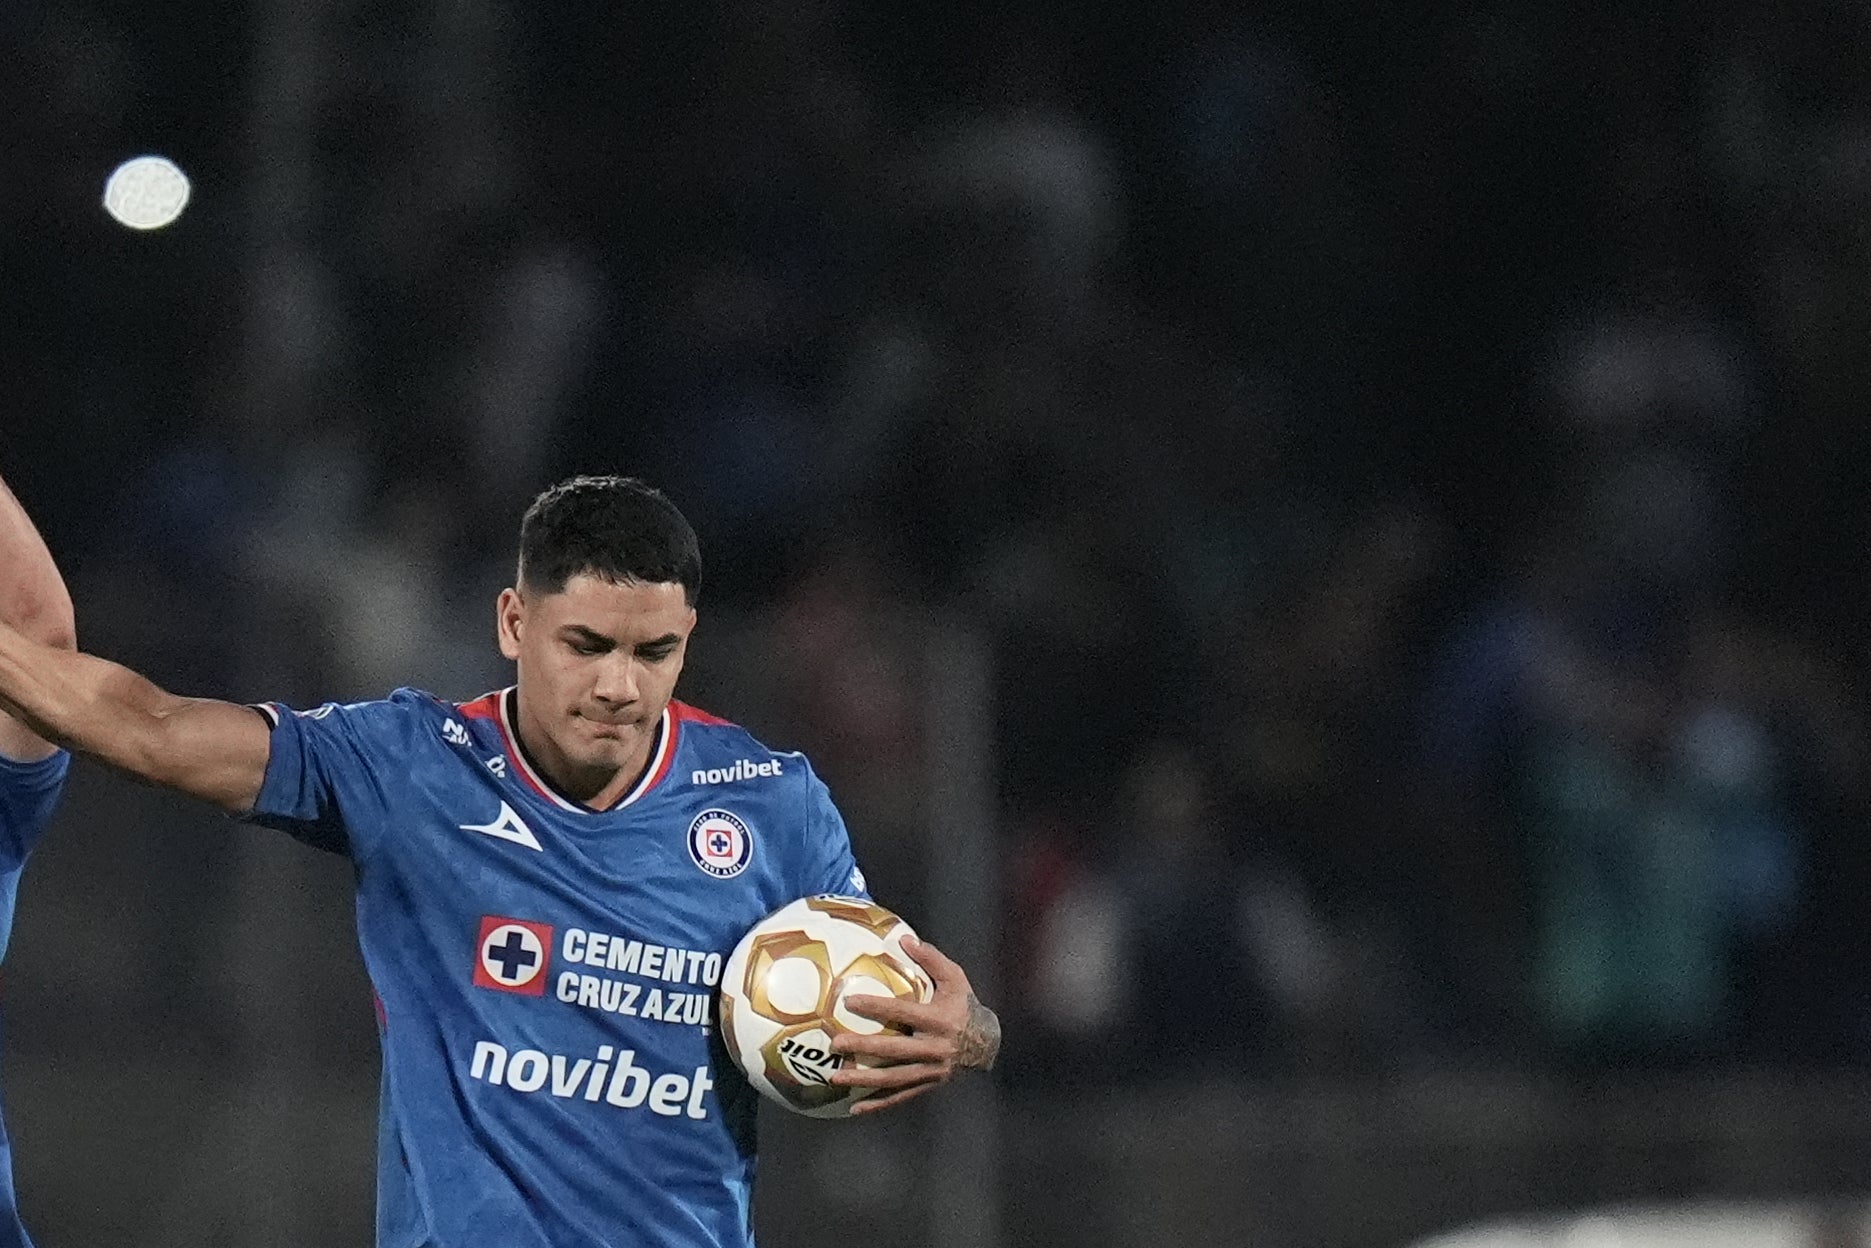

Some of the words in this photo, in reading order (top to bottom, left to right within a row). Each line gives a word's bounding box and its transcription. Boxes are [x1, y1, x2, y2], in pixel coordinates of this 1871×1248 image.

[692, 759, 783, 784] novibet
[562, 928, 722, 987] CEMENTO
[556, 971, 641, 1016] CRUZ
[640, 988, 713, 1026] AZUL
[470, 1040, 714, 1119] novibet
